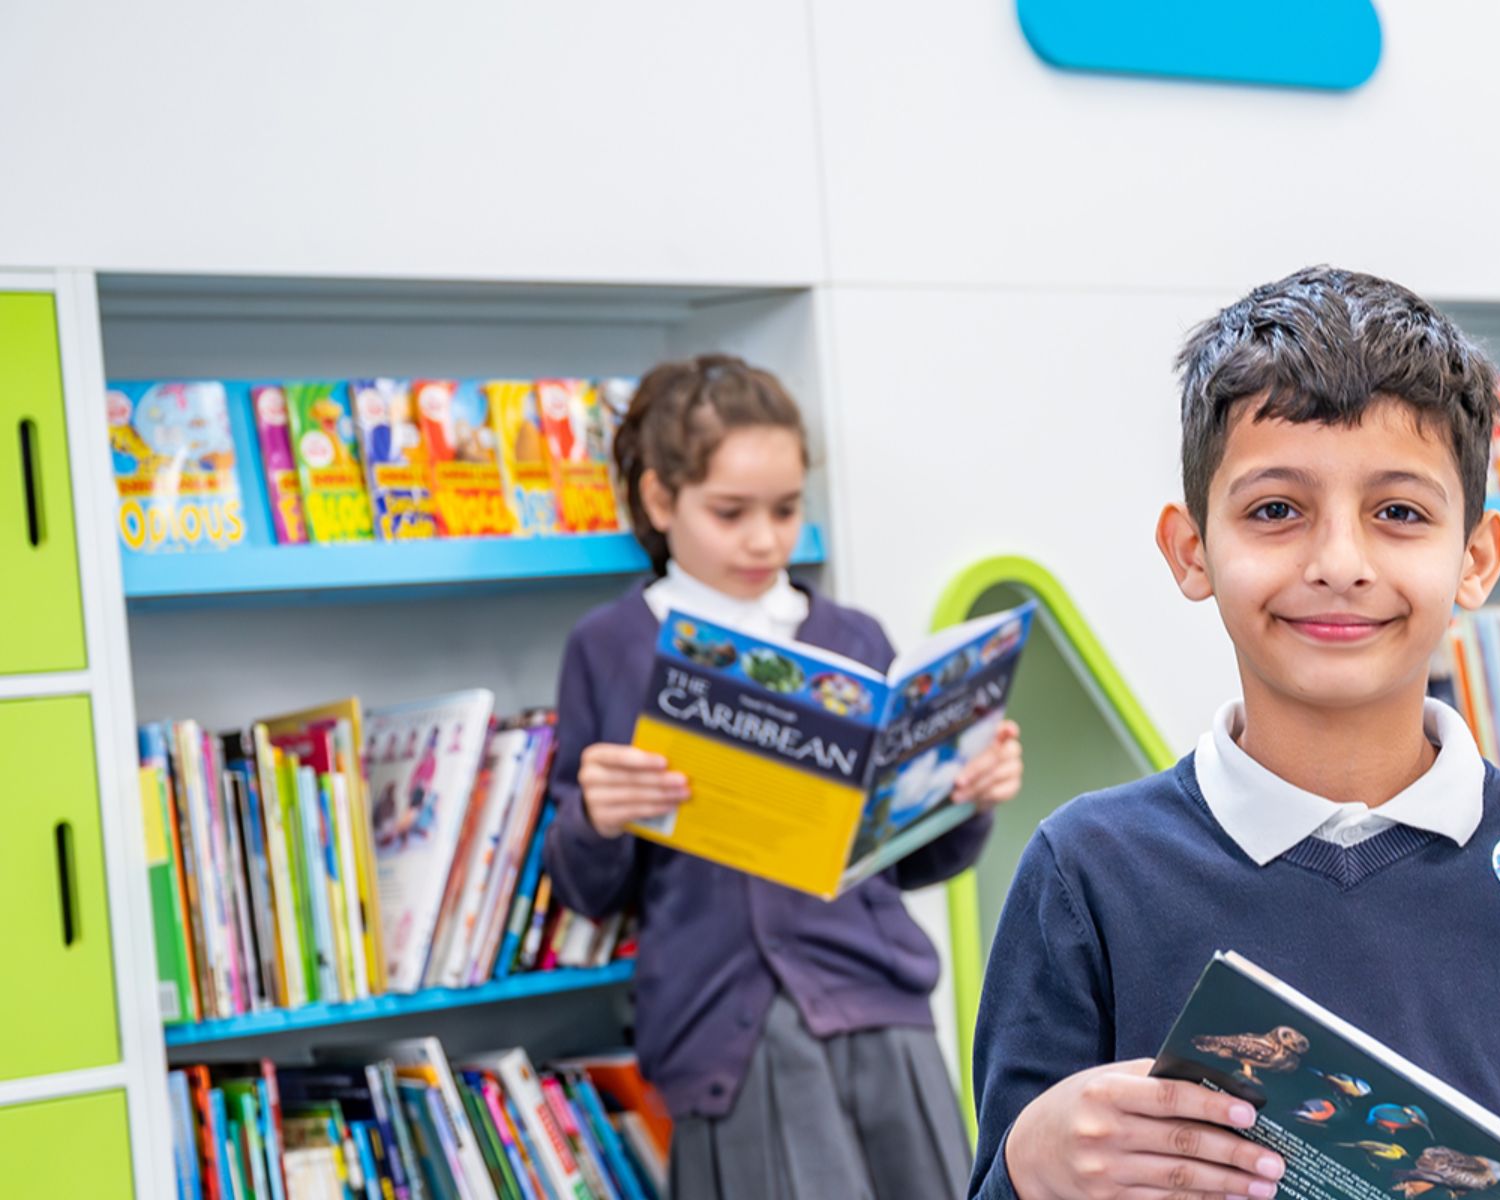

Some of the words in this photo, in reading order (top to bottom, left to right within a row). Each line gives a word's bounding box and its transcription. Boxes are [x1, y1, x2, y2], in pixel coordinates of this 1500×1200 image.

[119, 499, 244, 549] ODIOUS
[665, 666, 712, 694] THE
[658, 686, 857, 776] CARIBBEAN
